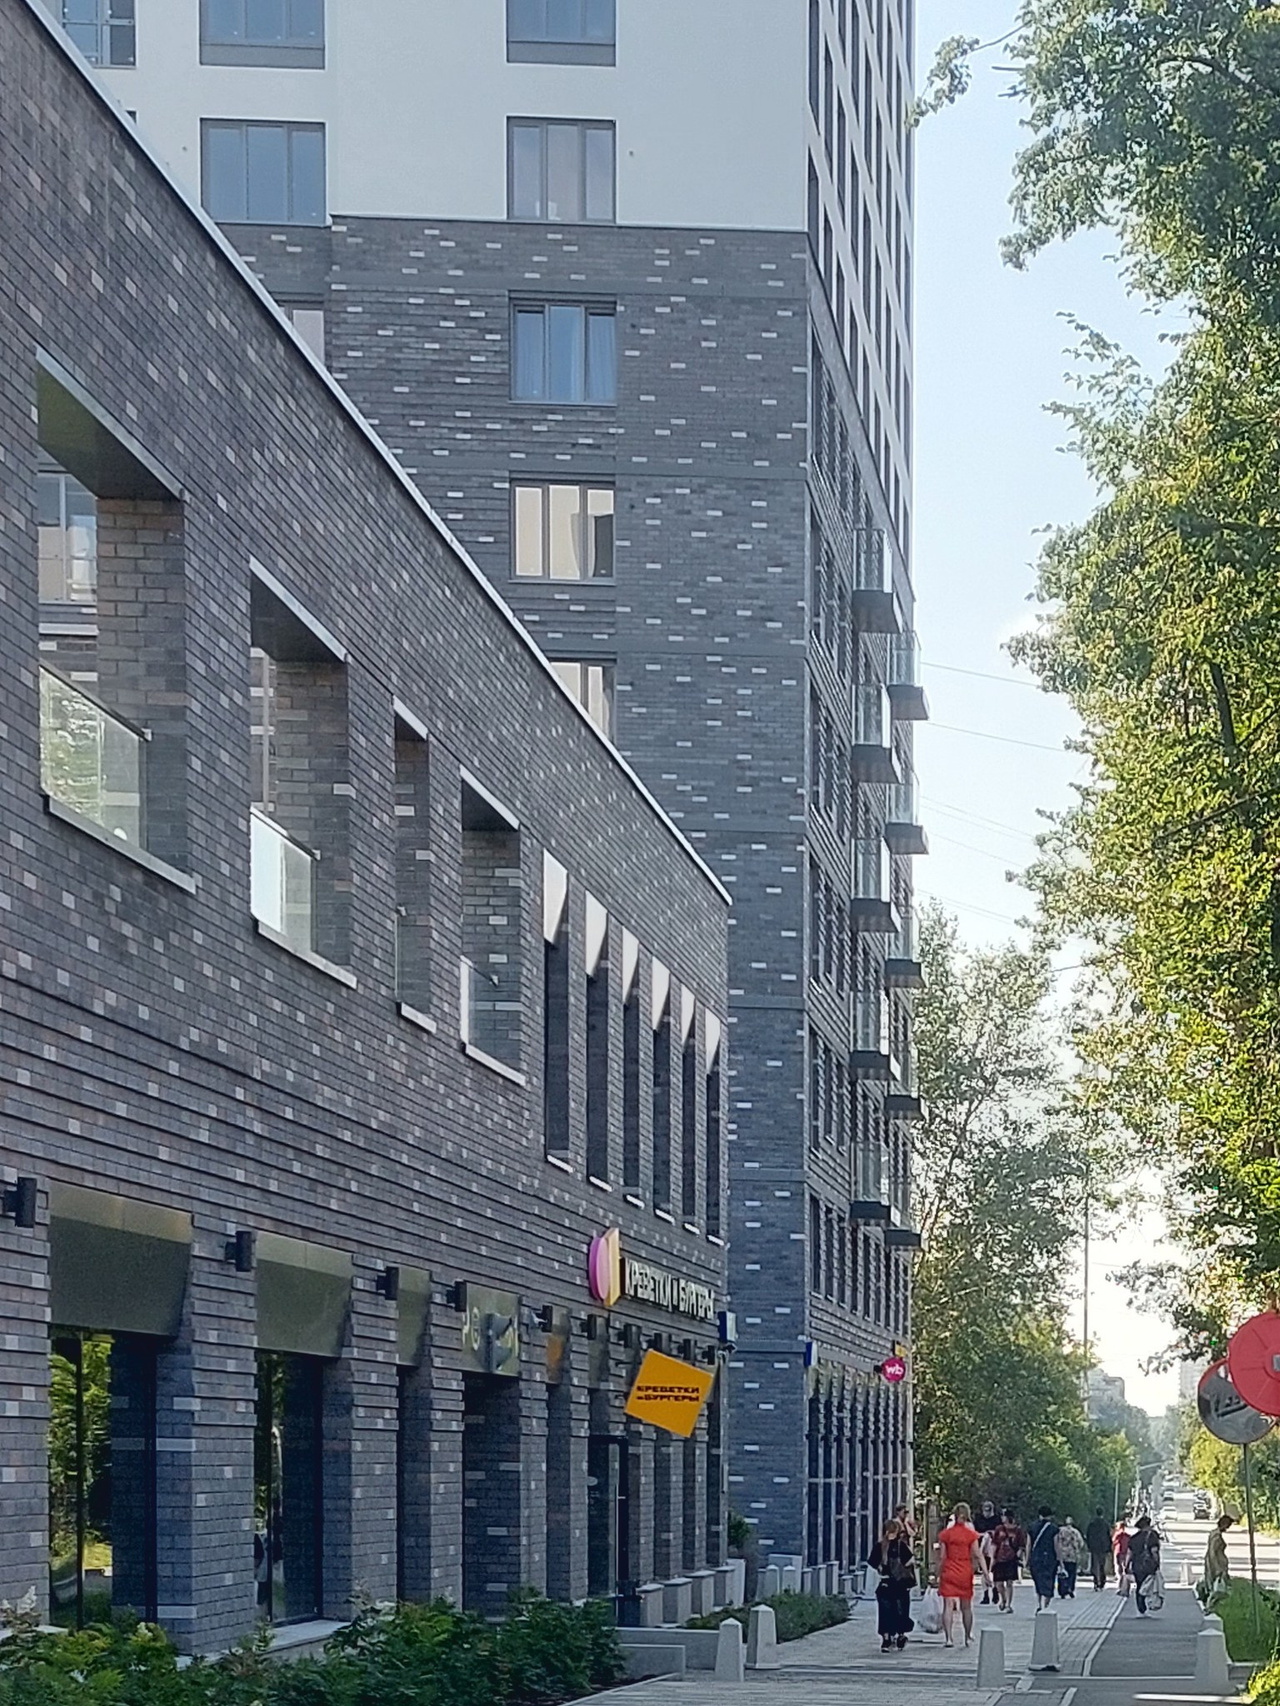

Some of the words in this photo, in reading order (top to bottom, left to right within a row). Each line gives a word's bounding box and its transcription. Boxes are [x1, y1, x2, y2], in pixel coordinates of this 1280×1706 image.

[625, 1257, 672, 1312] КРЕВЕТКИ
[678, 1278, 714, 1320] БУРГЕРЫ
[884, 1362, 904, 1375] wb
